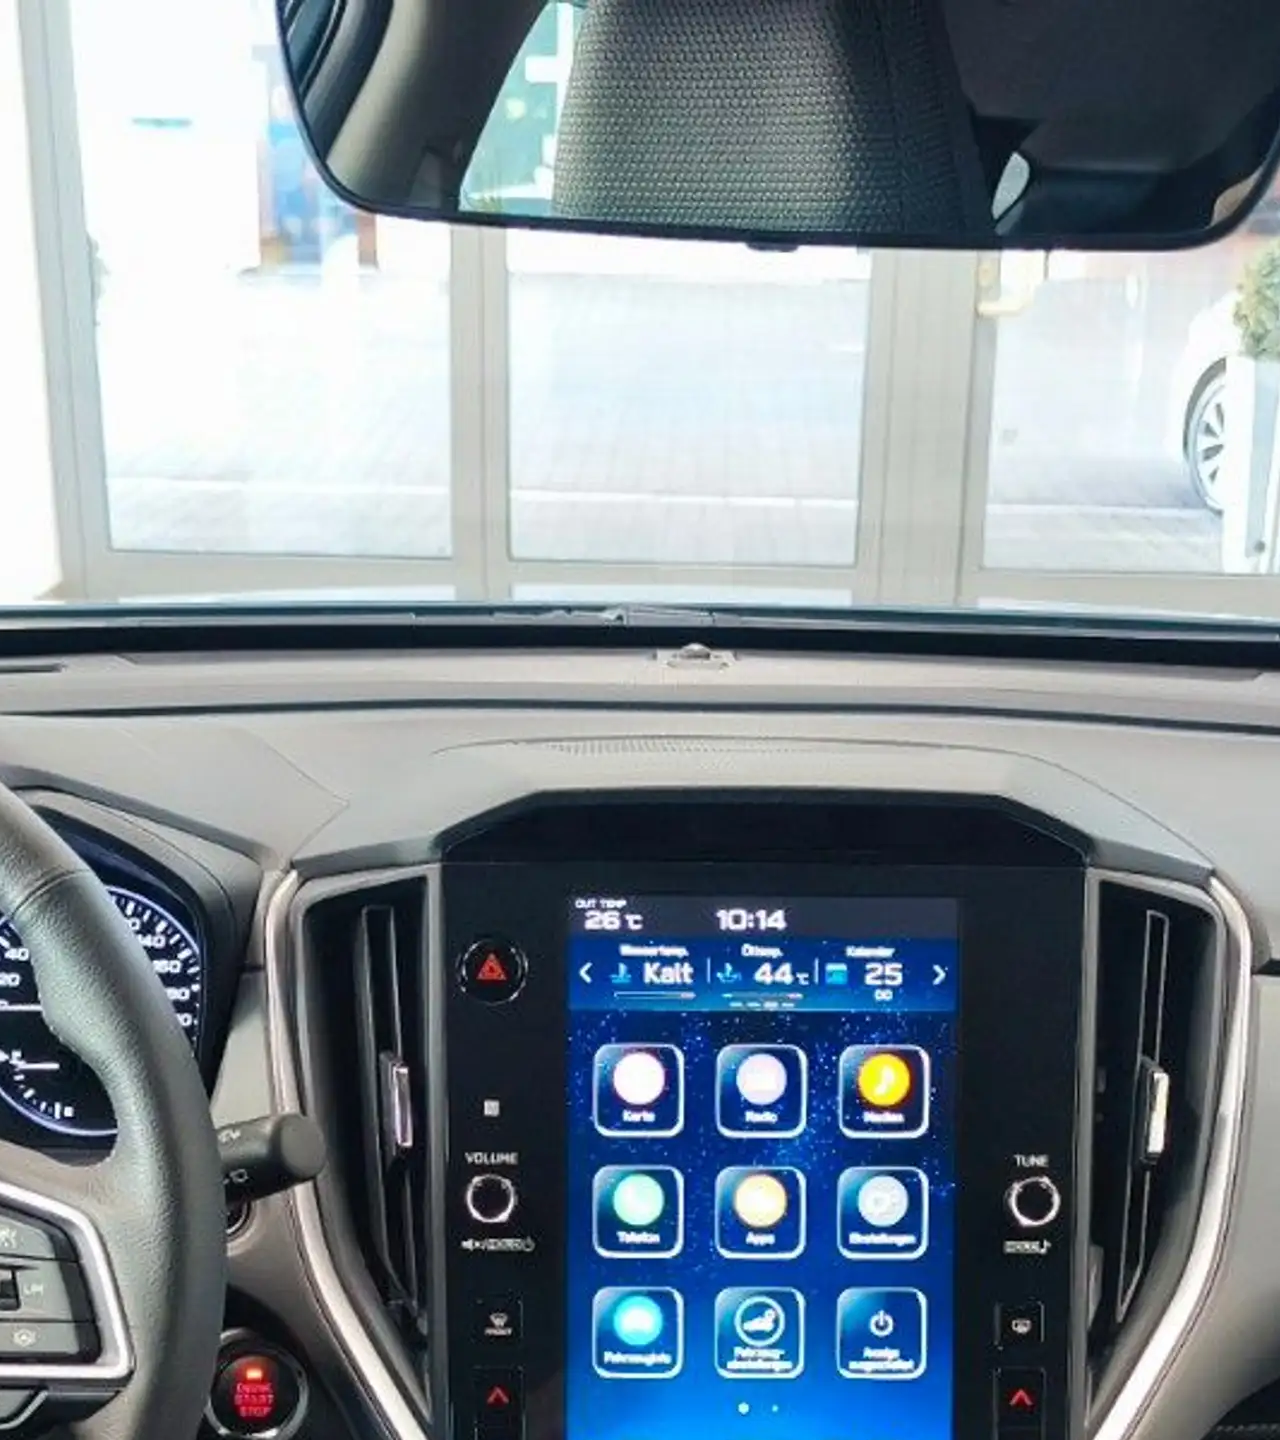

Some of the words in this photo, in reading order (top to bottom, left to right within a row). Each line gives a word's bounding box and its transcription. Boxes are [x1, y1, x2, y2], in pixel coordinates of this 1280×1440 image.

[584, 909, 620, 930] 26
[716, 909, 787, 931] 10:14
[5, 948, 29, 961] 40
[644, 962, 693, 985] Kalt
[754, 963, 793, 985] 44
[864, 962, 903, 986] 25
[745, 1110, 778, 1124] Radio
[465, 1152, 518, 1165] VOLUME
[1014, 1154, 1048, 1167] TUNE
[234, 1394, 274, 1405] START
[240, 1406, 272, 1417] STOP
